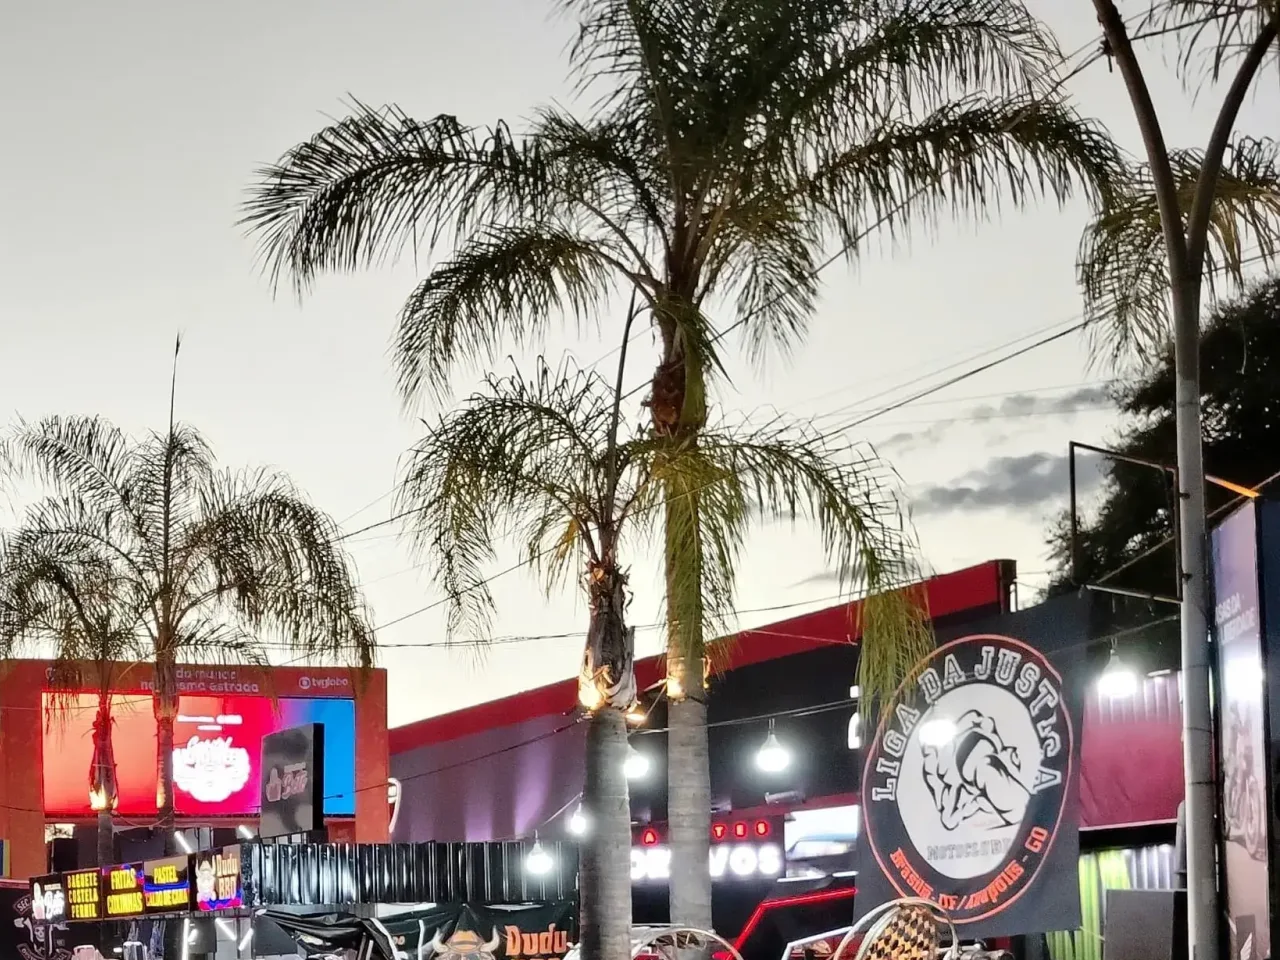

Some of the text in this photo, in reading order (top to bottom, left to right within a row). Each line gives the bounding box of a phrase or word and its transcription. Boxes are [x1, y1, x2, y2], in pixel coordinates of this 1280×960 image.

[872, 703, 921, 802] LIGA
[917, 653, 966, 705] DA
[1024, 826, 1049, 853] GO
[67, 872, 99, 889] BAGUETE
[110, 867, 137, 890] FRITAS
[153, 865, 179, 884] PASTEL
[68, 888, 99, 904] COSTELA
[71, 903, 97, 918] PERNIL
[504, 923, 567, 956] Dudu
